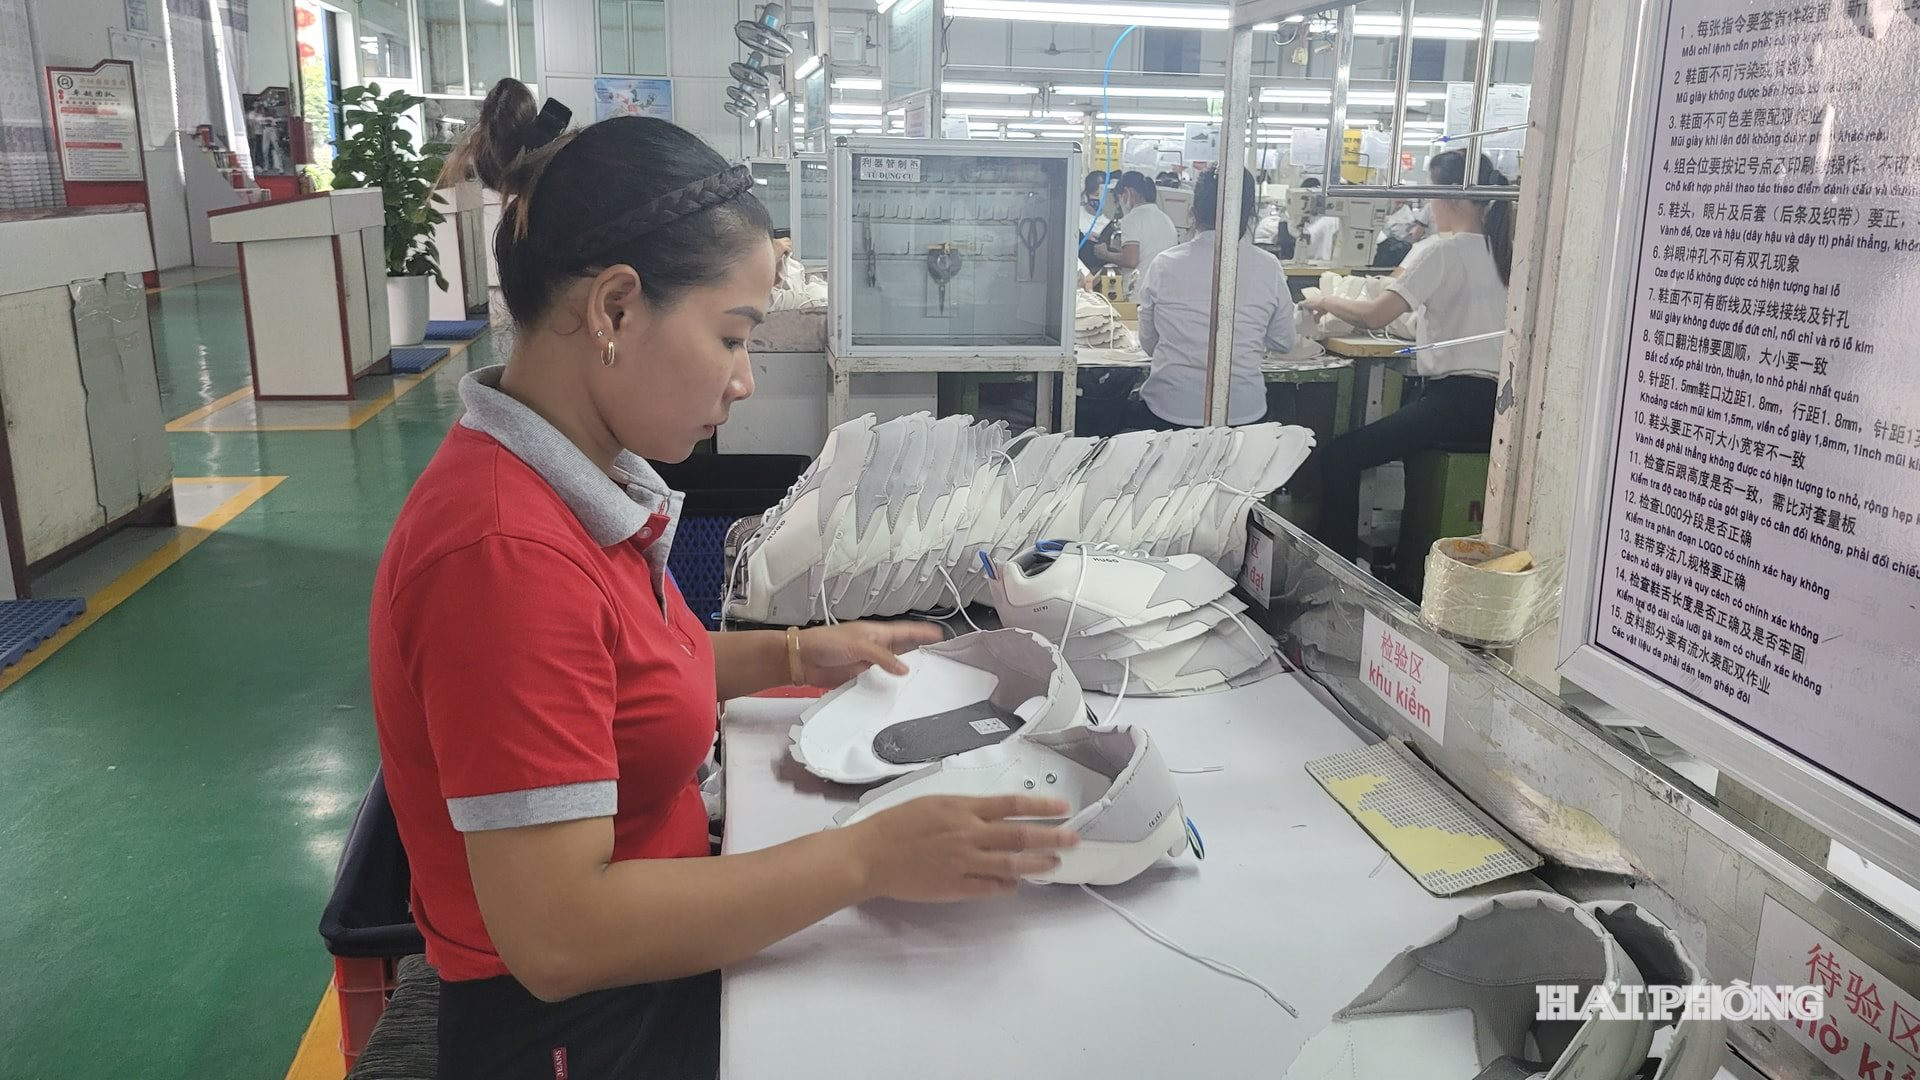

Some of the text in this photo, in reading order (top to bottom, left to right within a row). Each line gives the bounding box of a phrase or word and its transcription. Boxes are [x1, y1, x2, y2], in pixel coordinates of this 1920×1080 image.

[1698, 538, 1723, 556] LOGO
[1381, 630, 1424, 685] 检验区
[1369, 660, 1431, 727] khu kiểm
[1805, 943, 1920, 1063] 待验区
[556, 1050, 564, 1077] JEANS
